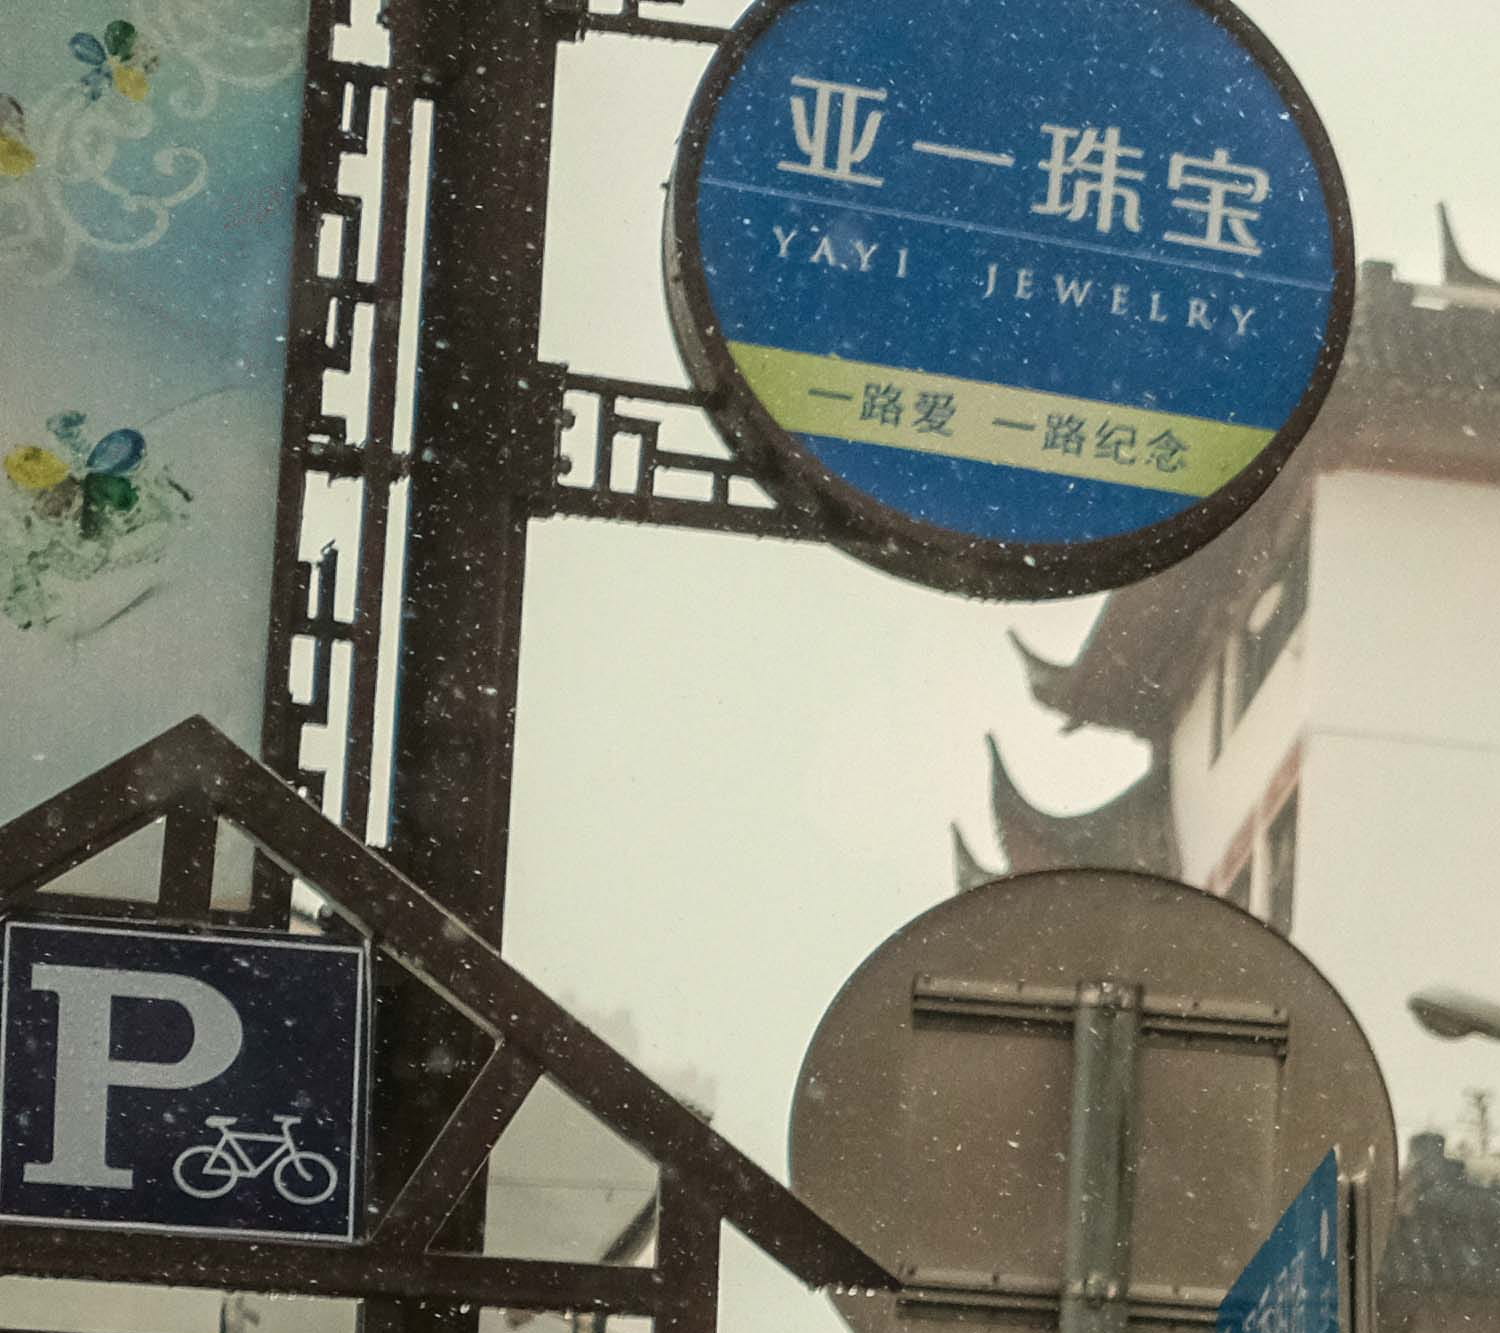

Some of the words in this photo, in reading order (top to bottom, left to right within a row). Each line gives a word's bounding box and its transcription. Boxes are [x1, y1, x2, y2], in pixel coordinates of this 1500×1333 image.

[776, 74, 1271, 257] 亚一珠宝
[772, 225, 910, 280] YAYI
[982, 263, 1257, 337] JEWELRY
[808, 380, 957, 438] 一路爱
[991, 408, 1192, 474] 一路纪念
[23, 963, 244, 1190] P
